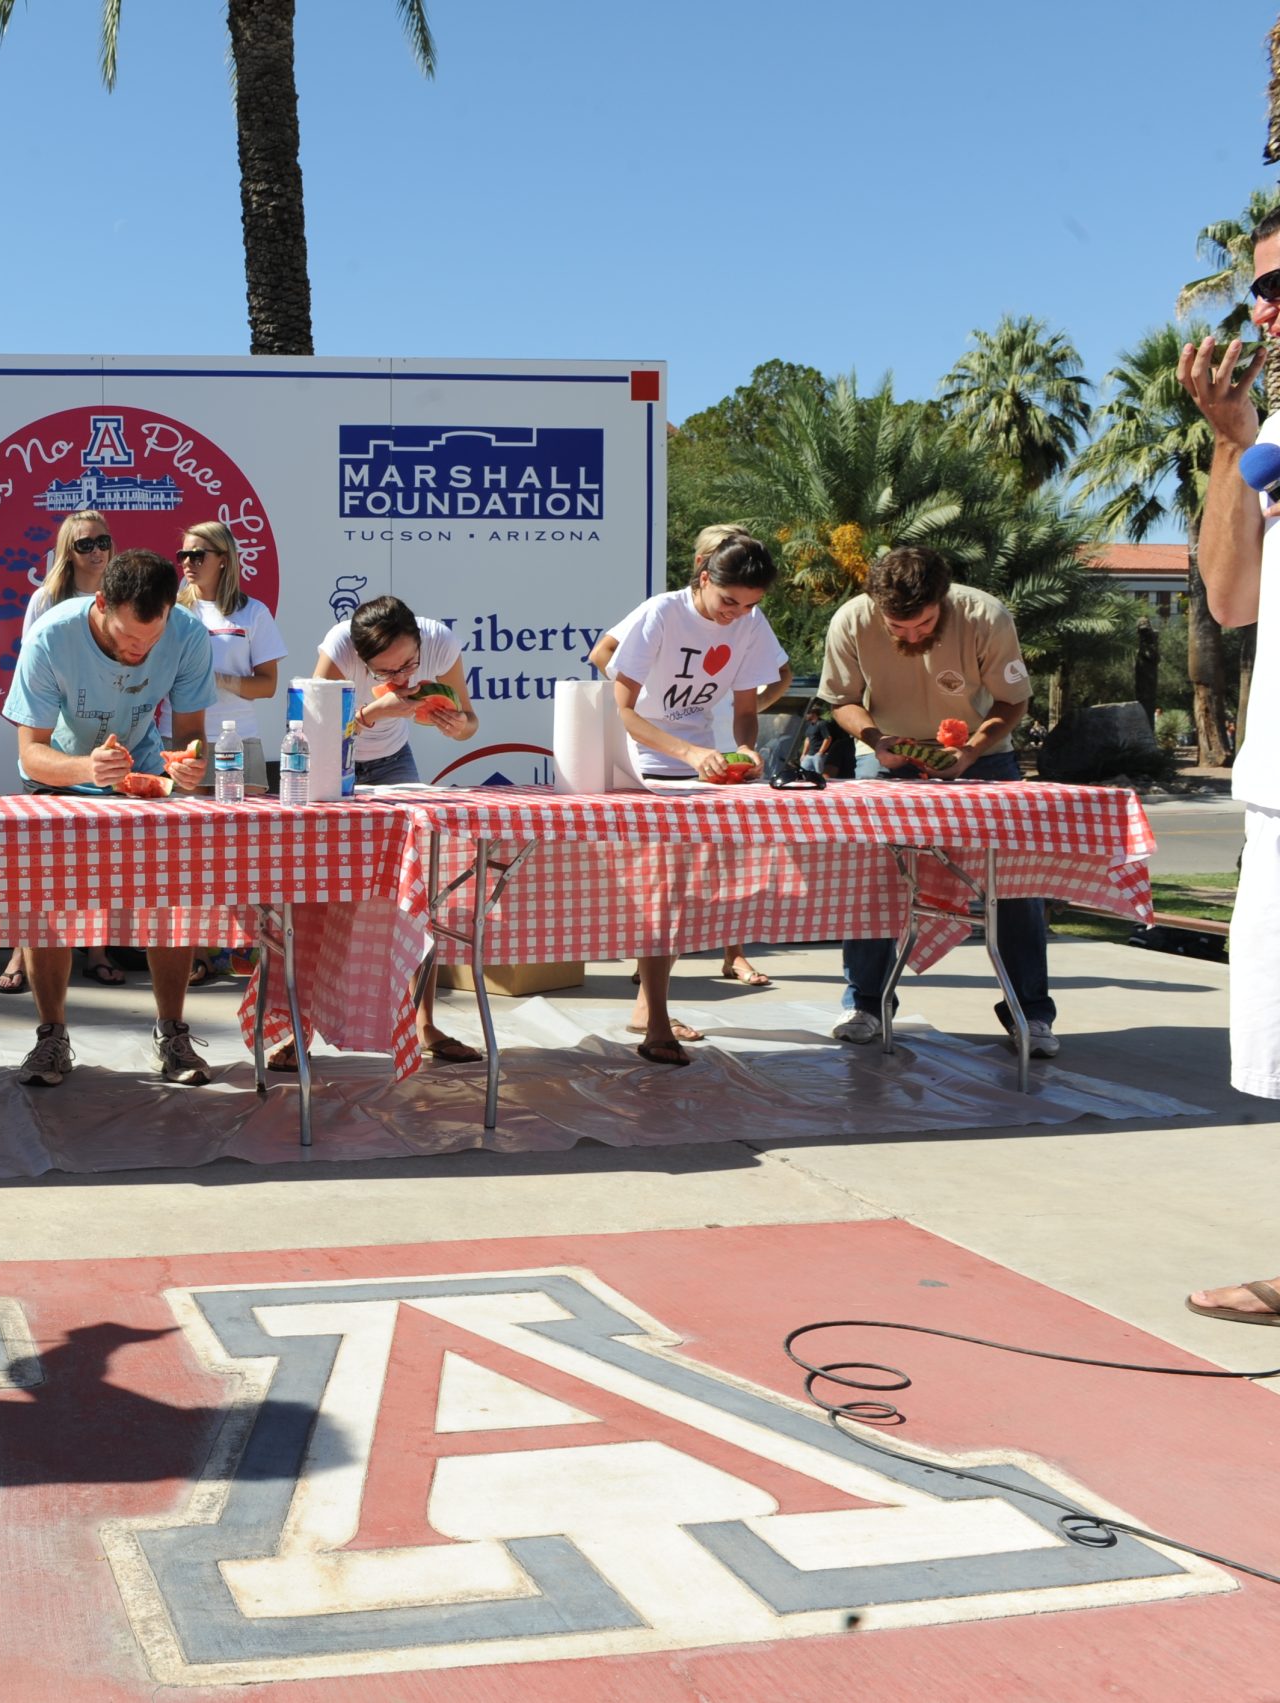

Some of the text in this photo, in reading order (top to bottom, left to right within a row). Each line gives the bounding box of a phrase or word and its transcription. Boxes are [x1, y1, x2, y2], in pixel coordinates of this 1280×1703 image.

[344, 464, 600, 489] MARSHALL
[6, 437, 74, 473] No
[81, 415, 134, 467] A
[141, 422, 222, 496] Place
[218, 497, 267, 582] Like
[344, 491, 600, 516] FOUNDATION
[344, 530, 601, 542] TUCSON ARIZONA
[441, 613, 604, 663] Liberty
[674, 647, 702, 679] I
[466, 666, 599, 700] Mutu
[663, 682, 718, 711] MB
